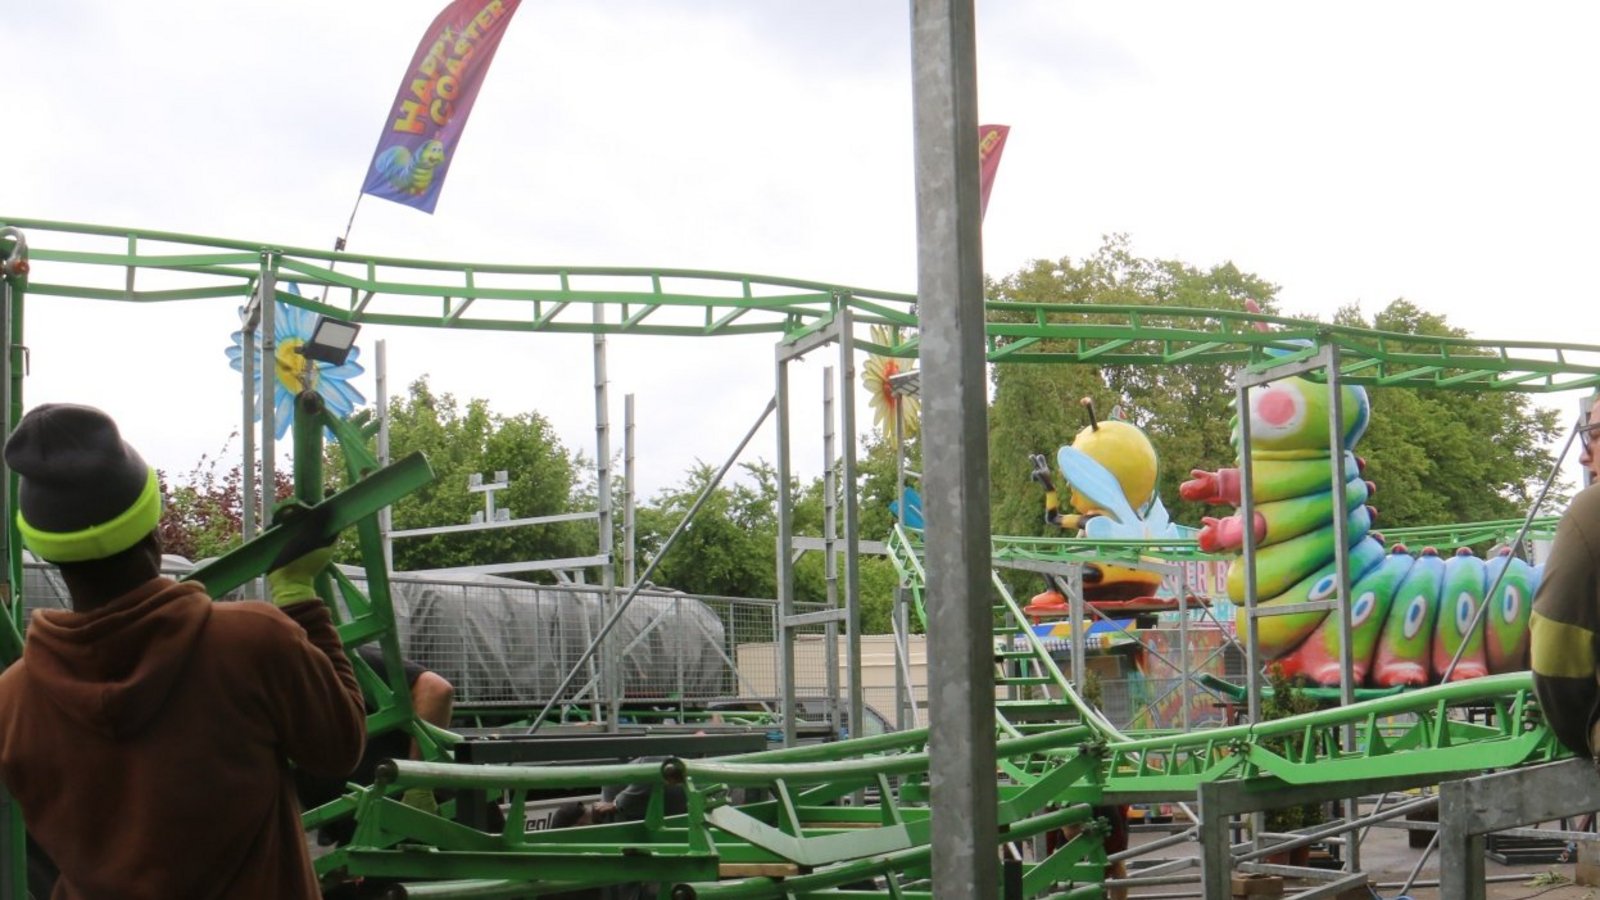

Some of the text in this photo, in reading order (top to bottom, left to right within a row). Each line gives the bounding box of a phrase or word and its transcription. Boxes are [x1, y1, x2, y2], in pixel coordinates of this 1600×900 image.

[393, 26, 454, 134] HAPPY
[430, 0, 506, 126] COASTER
[979, 130, 1003, 159] ER
